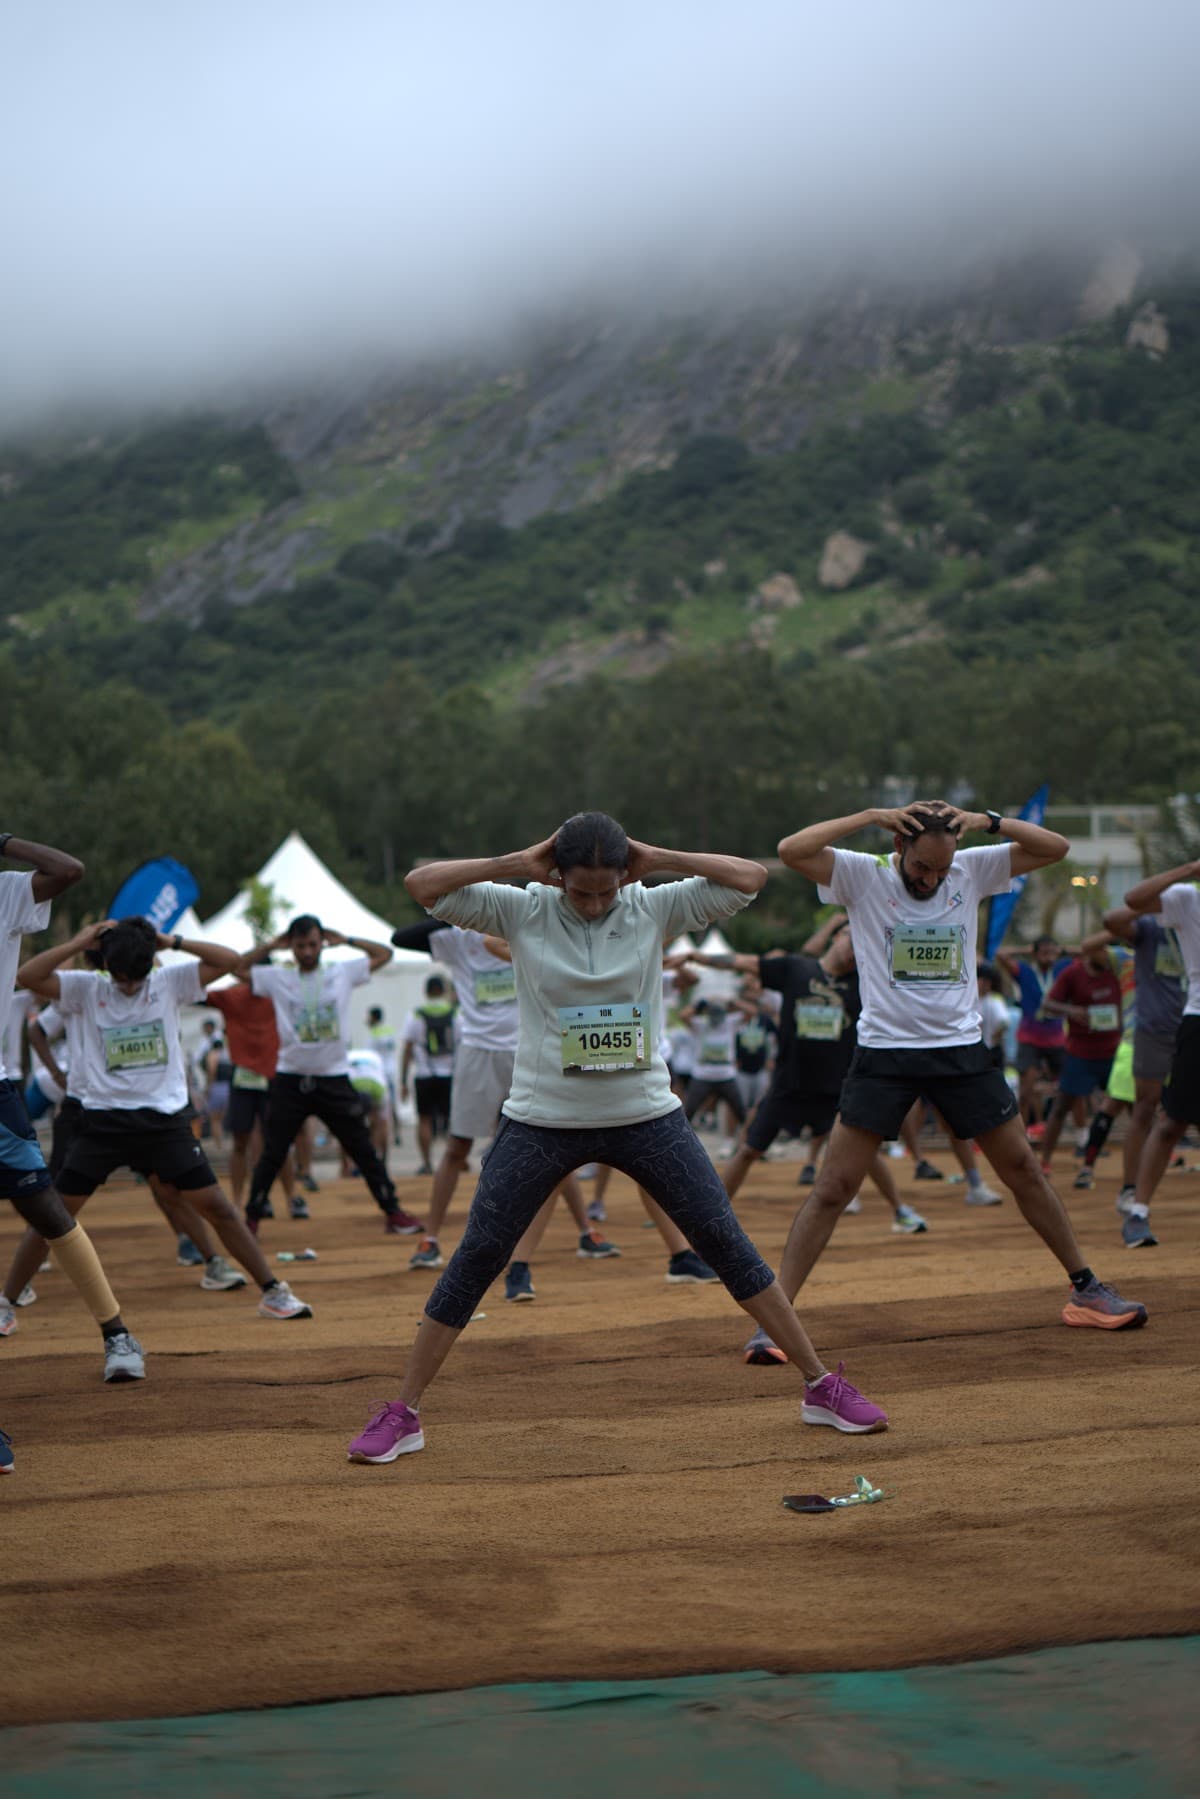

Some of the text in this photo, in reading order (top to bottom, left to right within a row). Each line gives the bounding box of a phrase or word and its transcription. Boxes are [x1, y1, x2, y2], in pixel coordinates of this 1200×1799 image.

[908, 946, 949, 960] 12827
[600, 1008, 612, 1016] 10K
[579, 1031, 631, 1049] 10455
[119, 1040, 153, 1055] 14011
